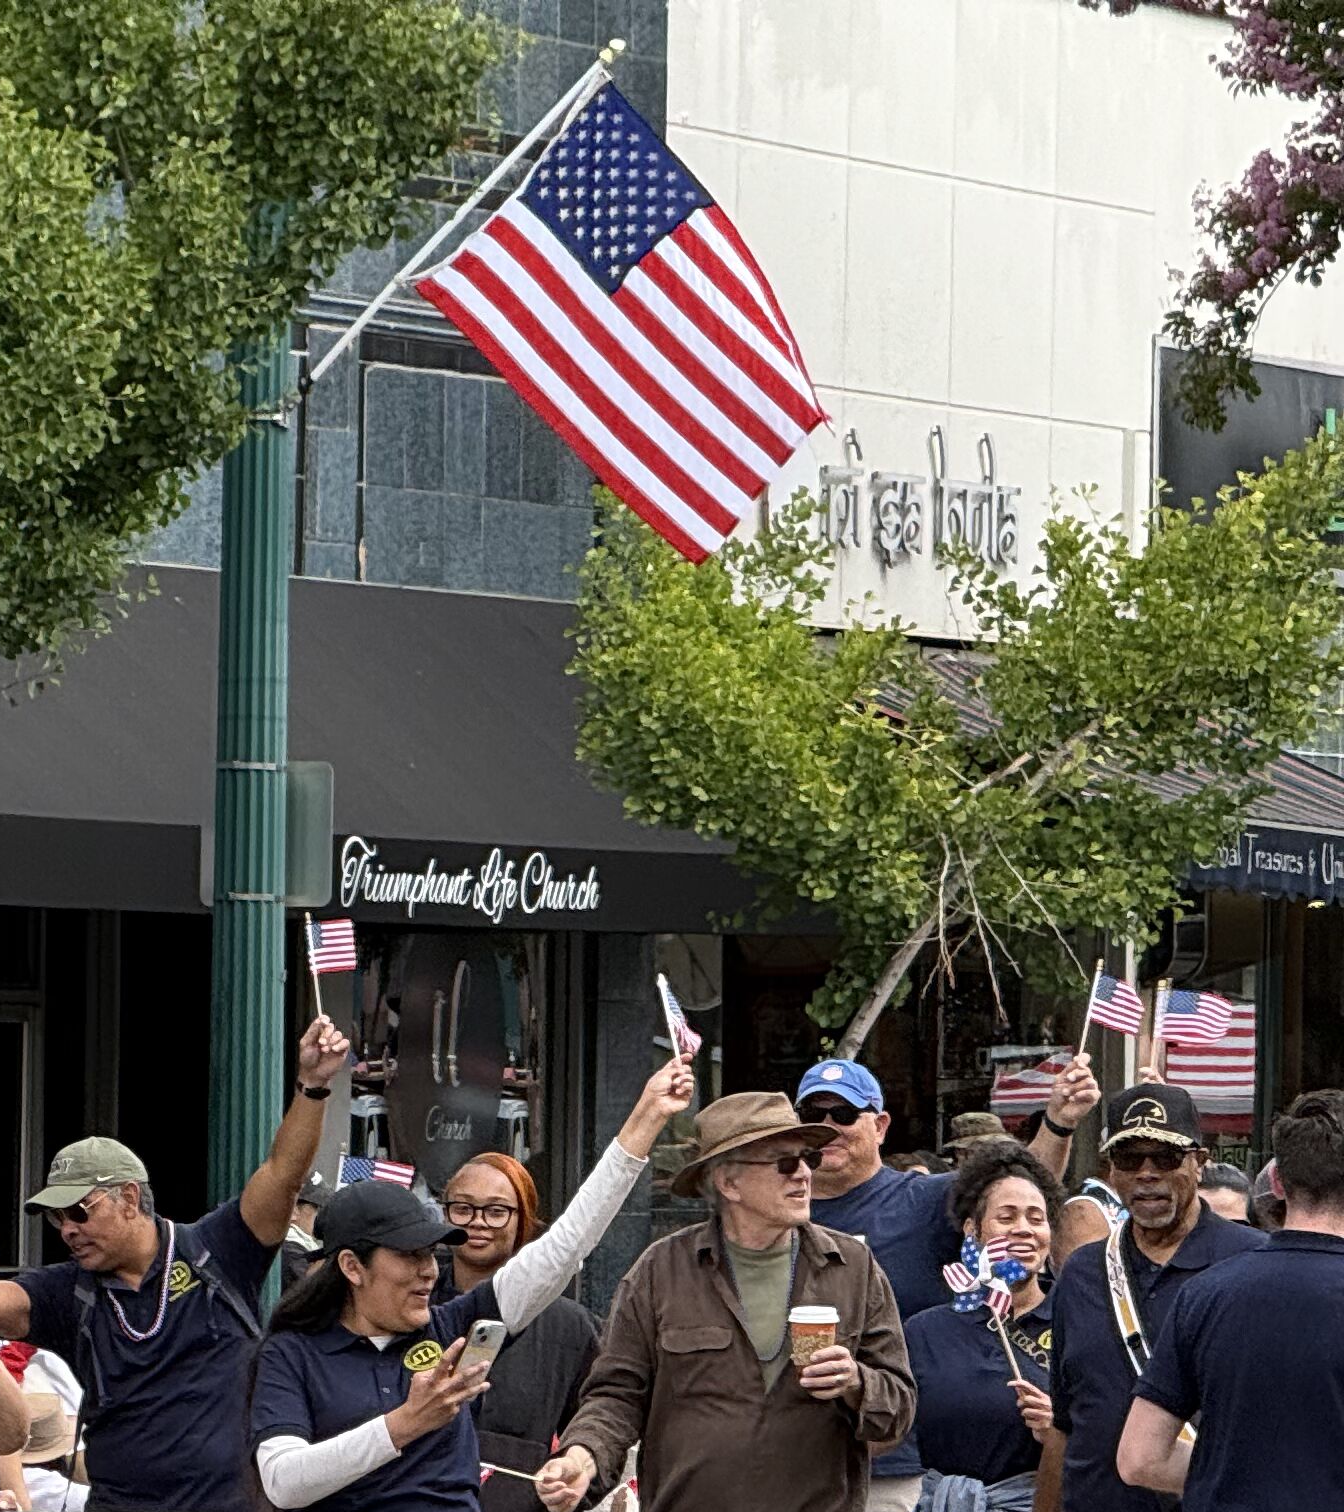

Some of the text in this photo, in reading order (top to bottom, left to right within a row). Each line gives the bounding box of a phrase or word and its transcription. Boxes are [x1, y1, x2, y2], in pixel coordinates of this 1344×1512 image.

[340, 835, 600, 924] Triumphant Life Church
